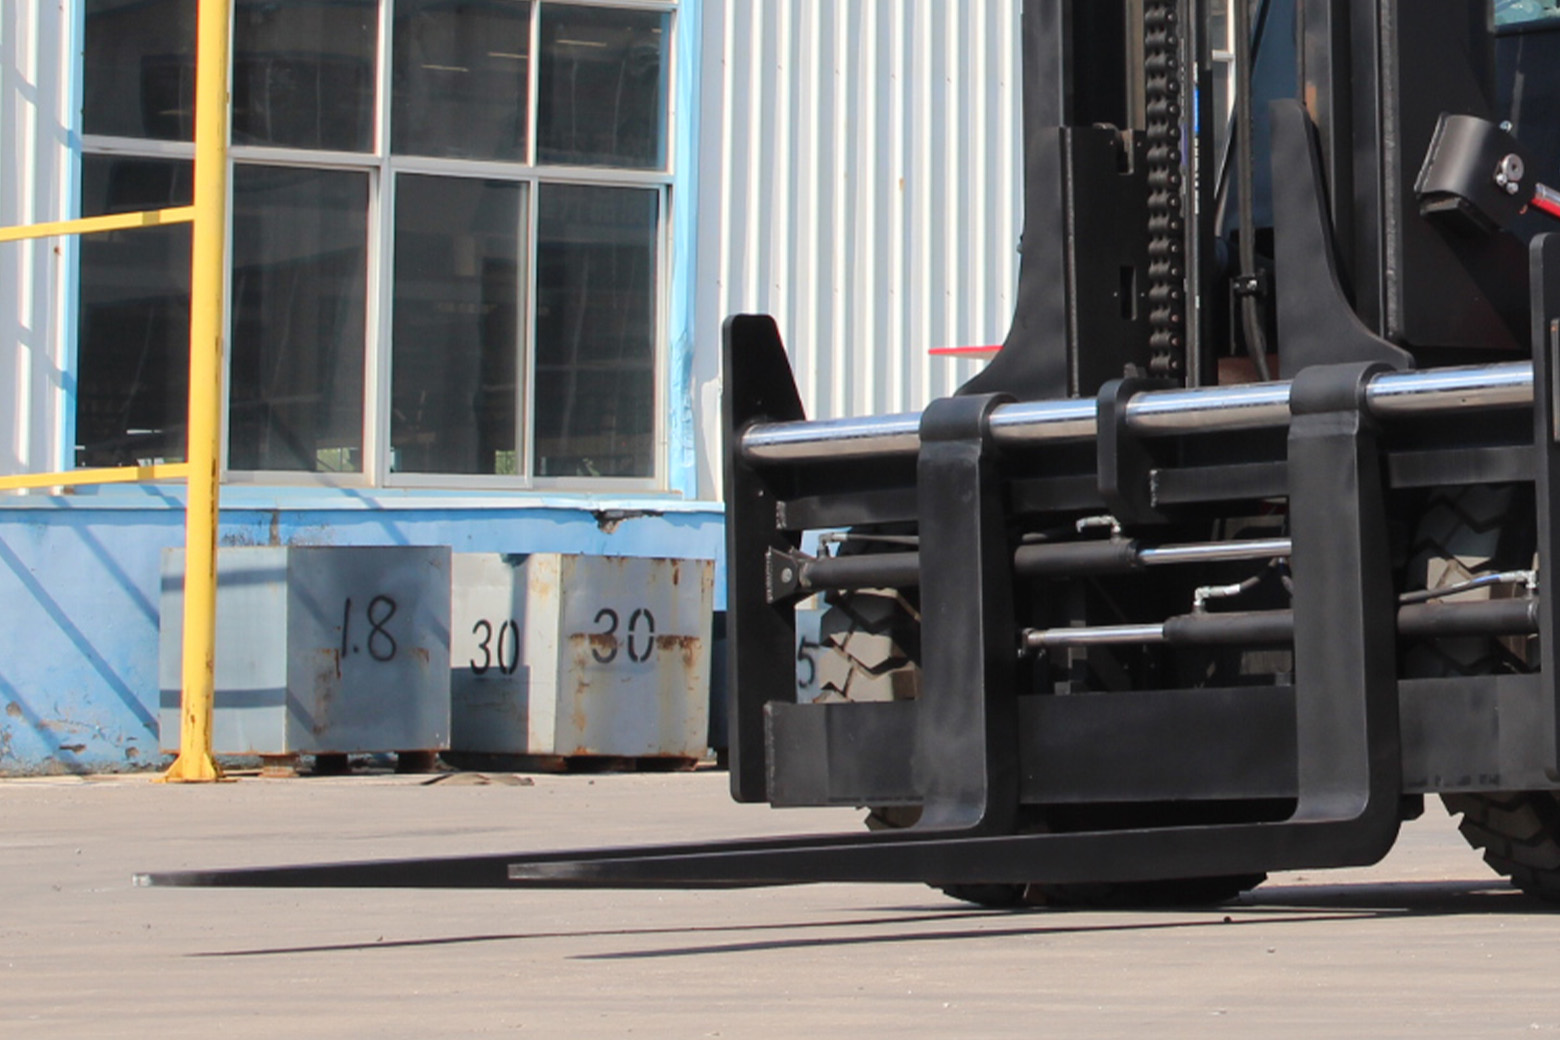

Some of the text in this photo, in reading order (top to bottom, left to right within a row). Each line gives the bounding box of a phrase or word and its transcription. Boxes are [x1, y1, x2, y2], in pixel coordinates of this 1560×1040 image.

[341, 595, 397, 662] 1.8
[470, 619, 520, 676] 30
[592, 607, 656, 664] 30
